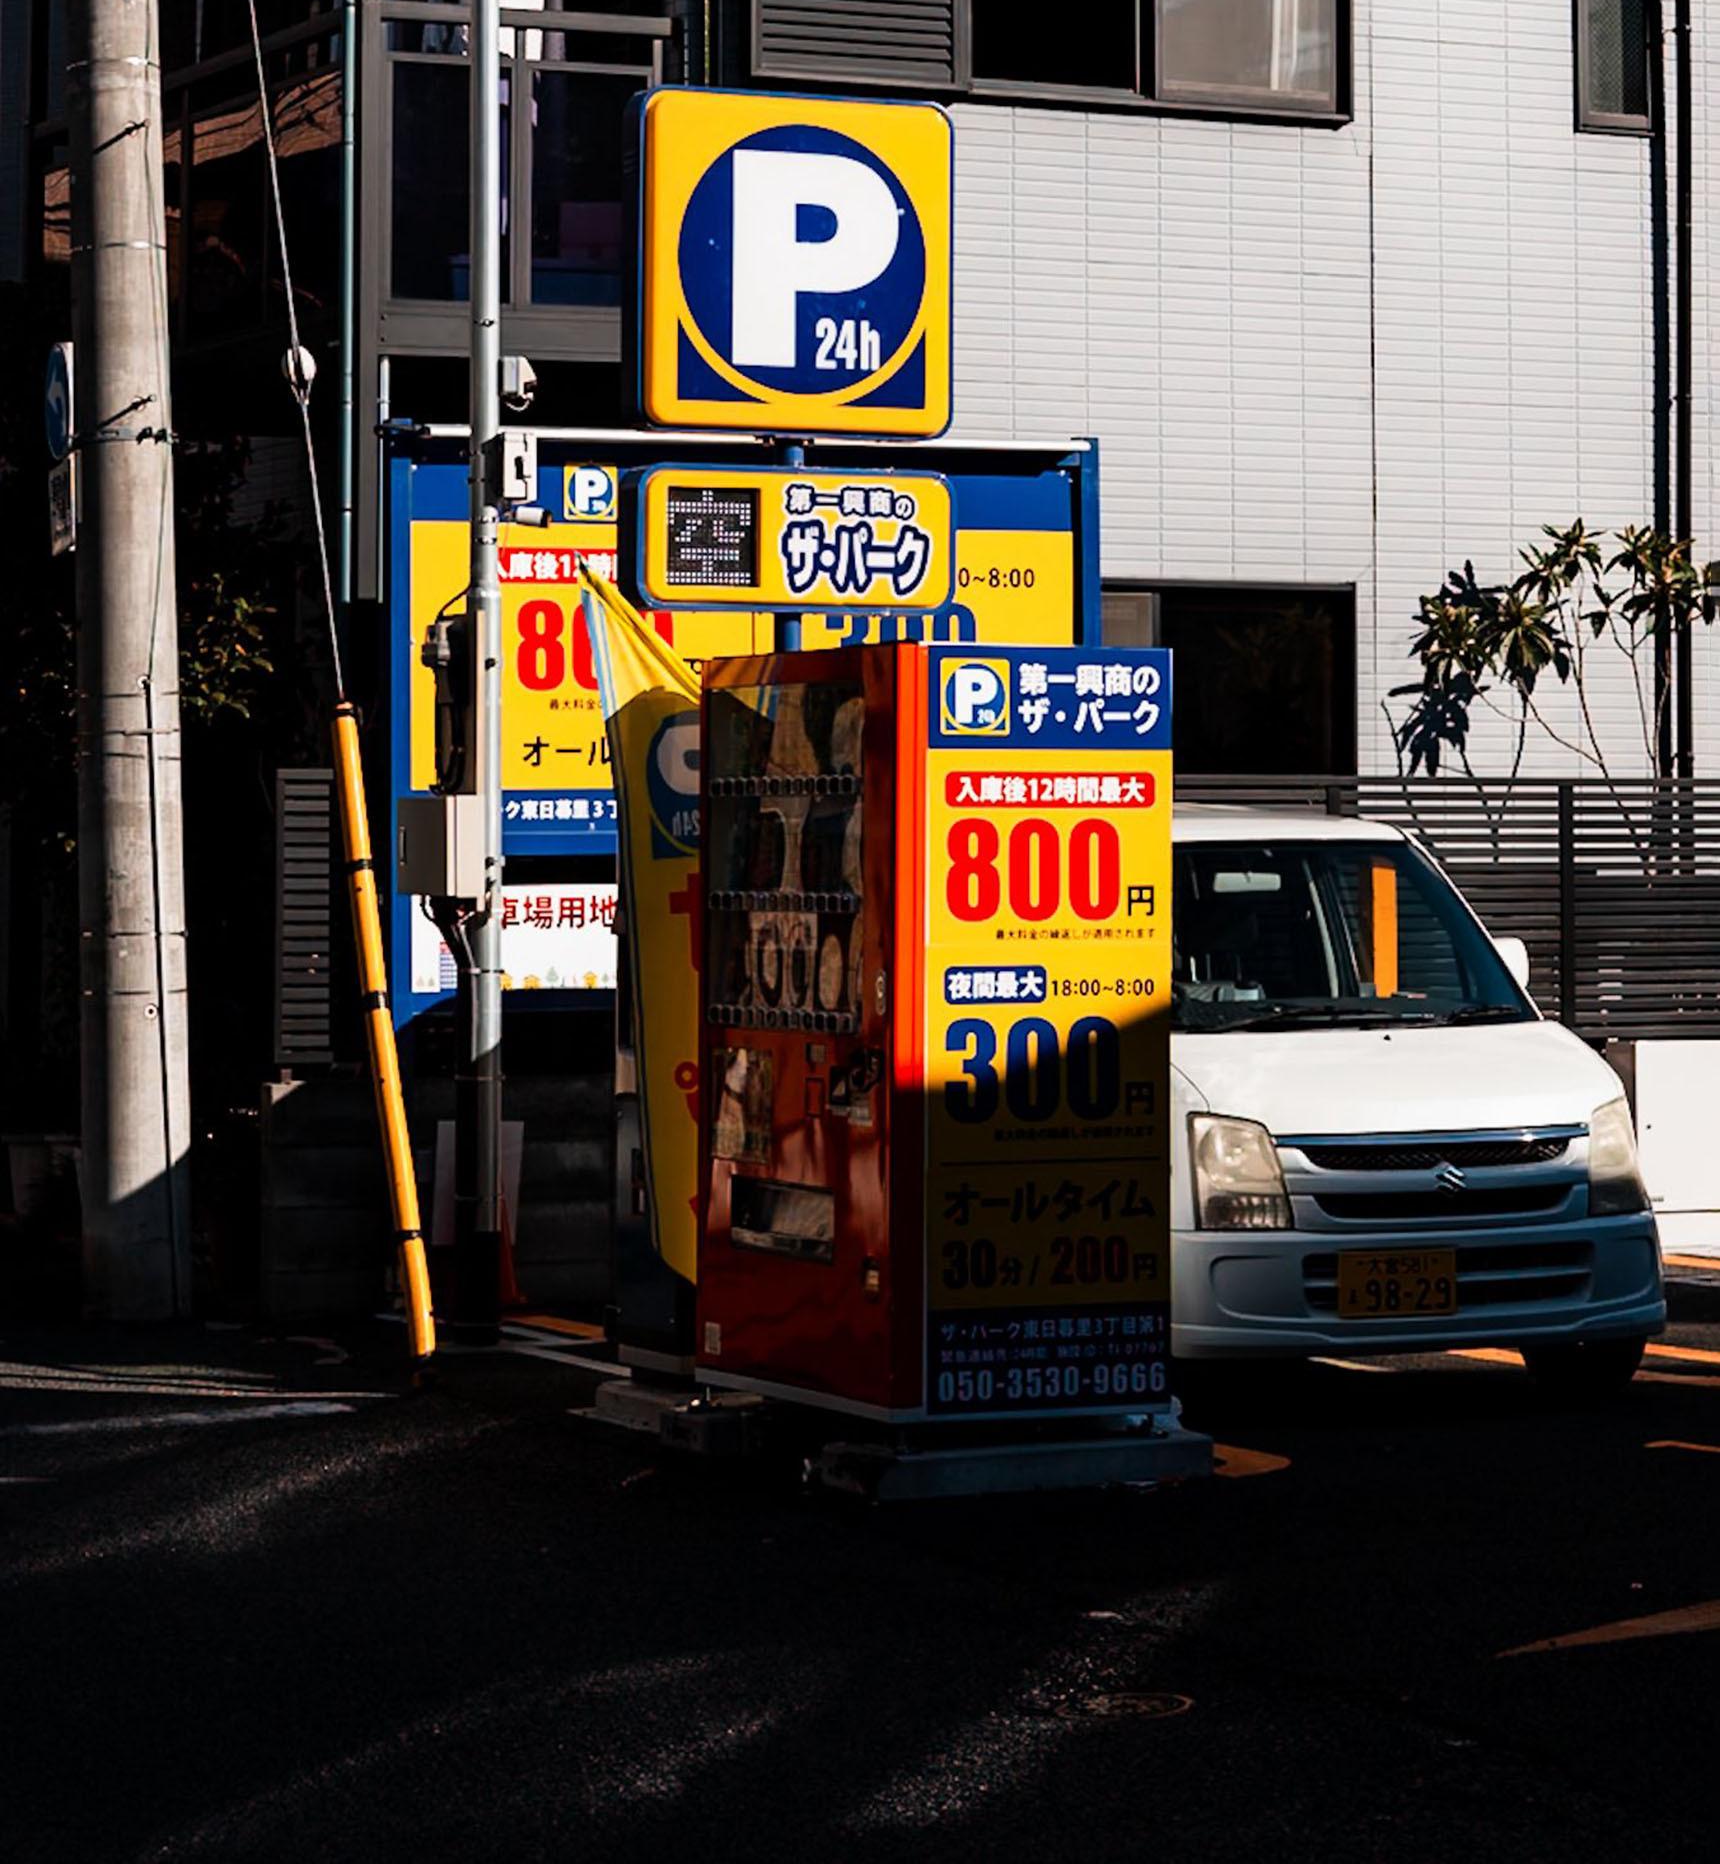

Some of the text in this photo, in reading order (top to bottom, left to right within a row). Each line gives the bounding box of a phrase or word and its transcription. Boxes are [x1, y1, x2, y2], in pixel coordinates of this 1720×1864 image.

[732, 149, 899, 367] P
[815, 317, 881, 371] 24h
[575, 469, 608, 511] P
[787, 485, 915, 519] 第一興商の
[667, 490, 752, 586] 空
[783, 520, 929, 594] ザ・パーク
[955, 669, 998, 724] P
[1018, 663, 1161, 696] 第一興商の
[1018, 700, 1160, 734] ザ・パーク
[956, 776, 1145, 804] 入庫後12時間最大
[947, 971, 1044, 1000] 夜間最大
[943, 1179, 1156, 1226] オールタイム
[1366, 1276, 1450, 1311] 98-29
[938, 1362, 1165, 1402] 050-3530-9666
